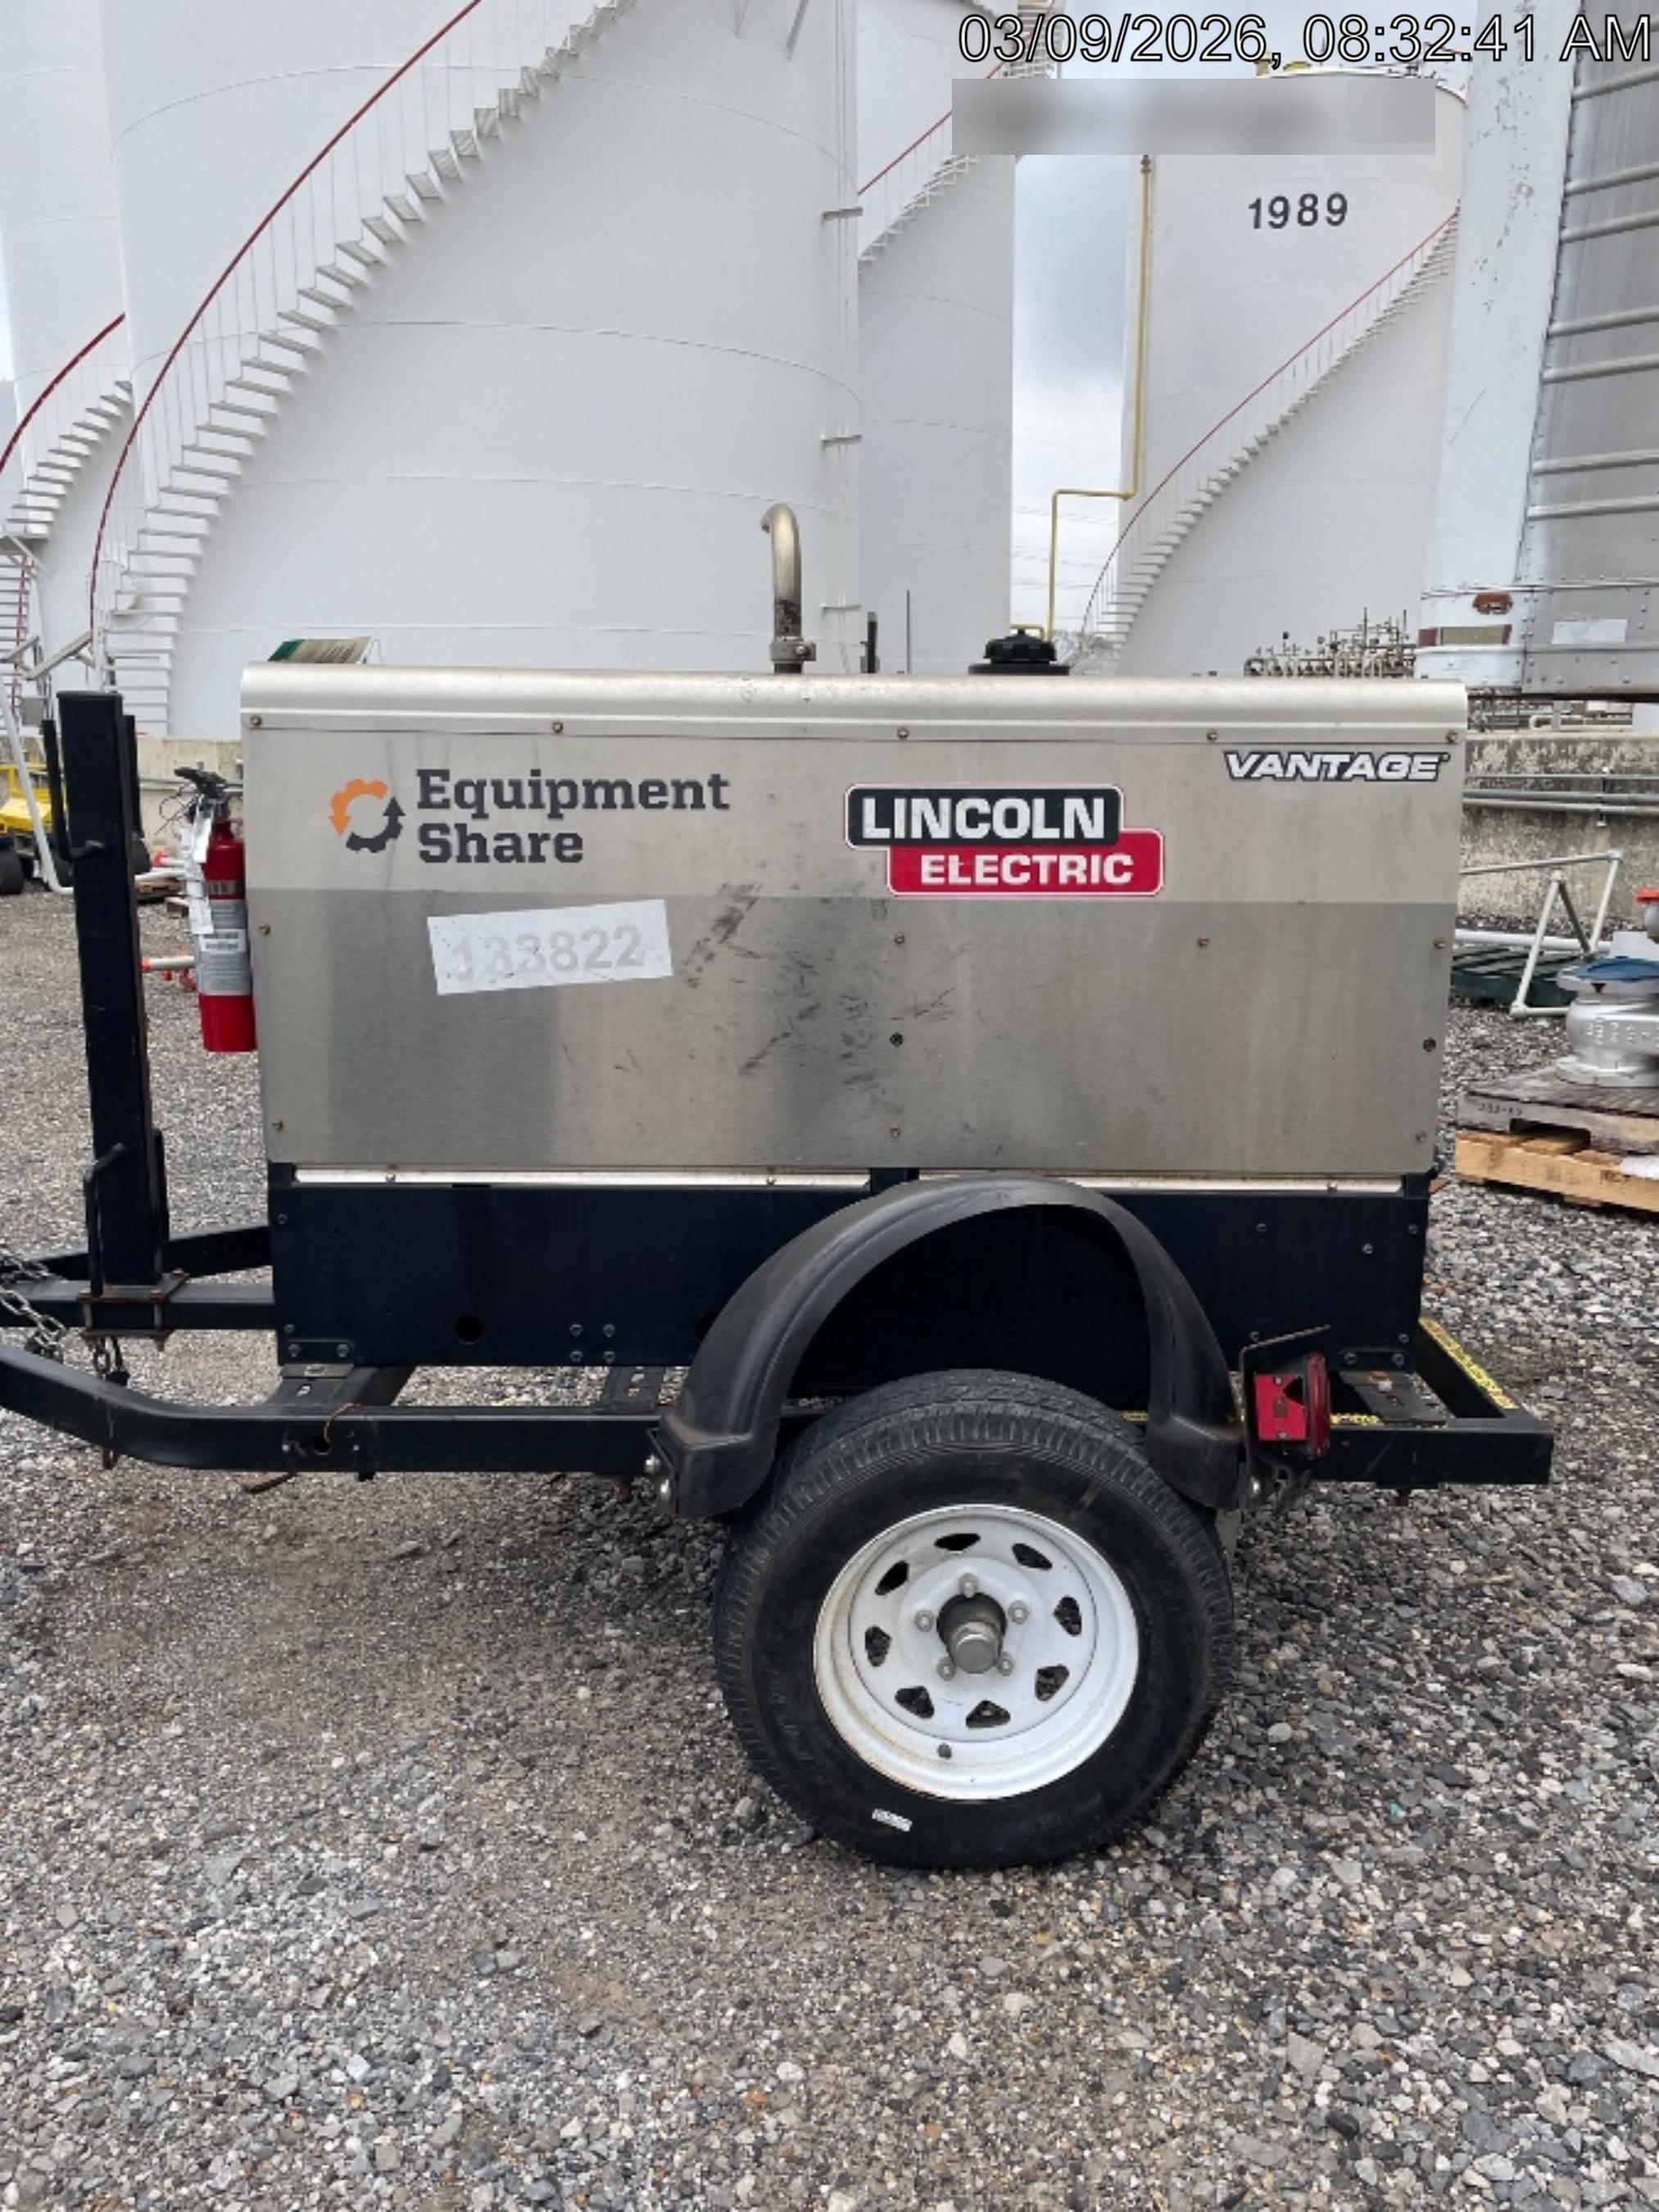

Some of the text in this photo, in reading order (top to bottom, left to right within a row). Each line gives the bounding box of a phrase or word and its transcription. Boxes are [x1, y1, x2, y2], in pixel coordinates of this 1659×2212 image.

[1248, 193, 1348, 229] 1989
[417, 768, 730, 819] Equipment
[861, 797, 1105, 841] LINCOLN
[419, 823, 583, 863] Share
[920, 854, 1134, 886] ELECTRIC
[451, 923, 646, 982] 133822
